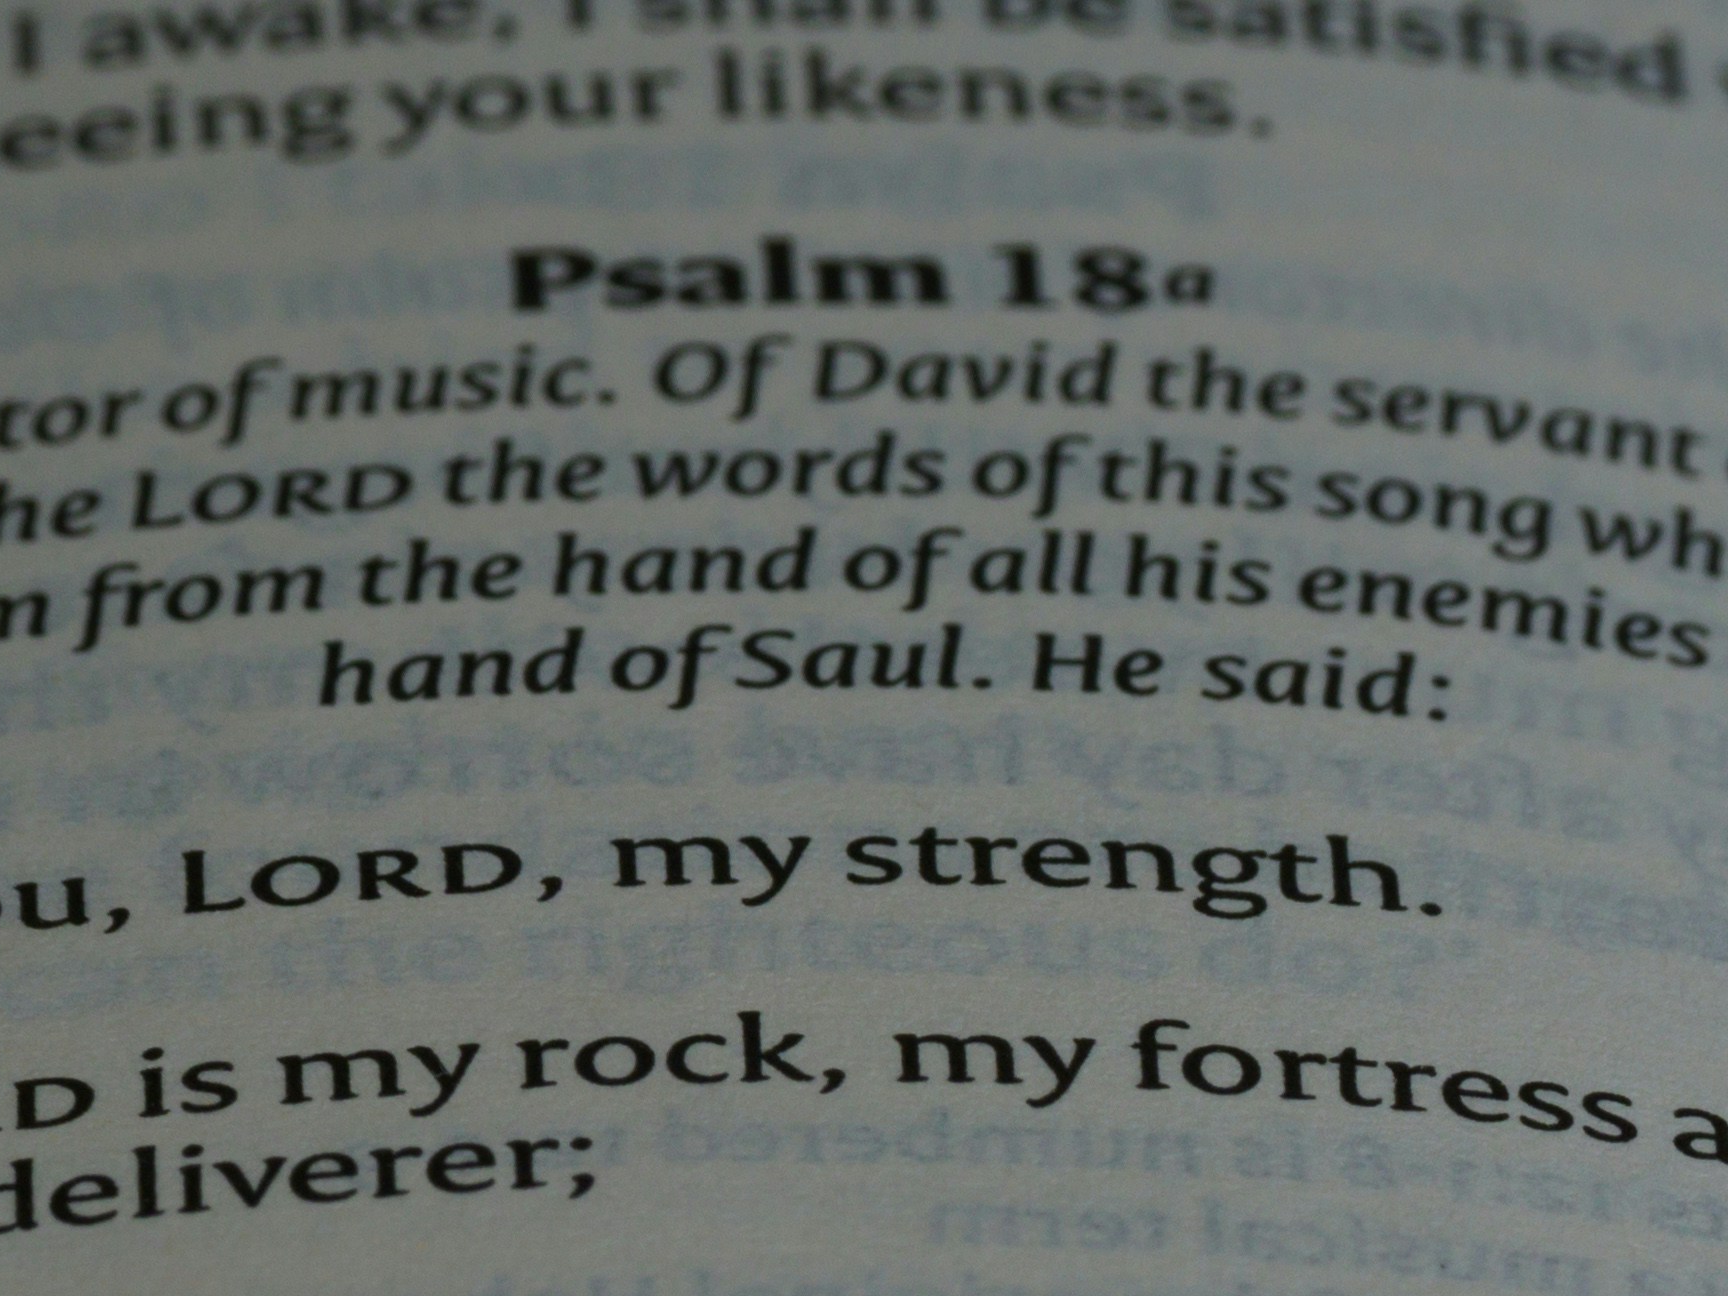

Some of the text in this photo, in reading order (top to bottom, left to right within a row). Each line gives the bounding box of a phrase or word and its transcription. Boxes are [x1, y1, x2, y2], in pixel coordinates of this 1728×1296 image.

[10, 10, 42, 76] I
[81, 0, 518, 70] awake,
[384, 72, 676, 155] your
[714, 46, 1274, 142] likeness.
[511, 236, 951, 312] Psalm
[160, 358, 280, 448] of
[289, 346, 618, 422] music.
[653, 336, 792, 423] Of
[814, 338, 1118, 408] David
[1146, 347, 1306, 420] the
[1333, 378, 1702, 480] servant
[132, 464, 415, 530] LORD
[444, 438, 608, 506] the
[633, 430, 945, 500] words
[972, 434, 1090, 520] of
[1098, 437, 1292, 513] this
[1315, 471, 1554, 563] song
[74, 561, 327, 655] from
[359, 538, 524, 608] the
[552, 526, 819, 598] hand
[843, 527, 966, 613] of
[968, 530, 1096, 598] all
[1124, 534, 1271, 606] his
[1296, 564, 1712, 670] enemies
[318, 622, 1452, 723] hand of Saul. He said:
[180, 844, 564, 916] LORD,
[611, 834, 814, 906] my
[844, 826, 1442, 920] strength.
[138, 1046, 240, 1118] is
[278, 1039, 482, 1118] my
[516, 1008, 848, 1094] rock,
[894, 1030, 1098, 1109] my
[1130, 1017, 1640, 1146] fortress
